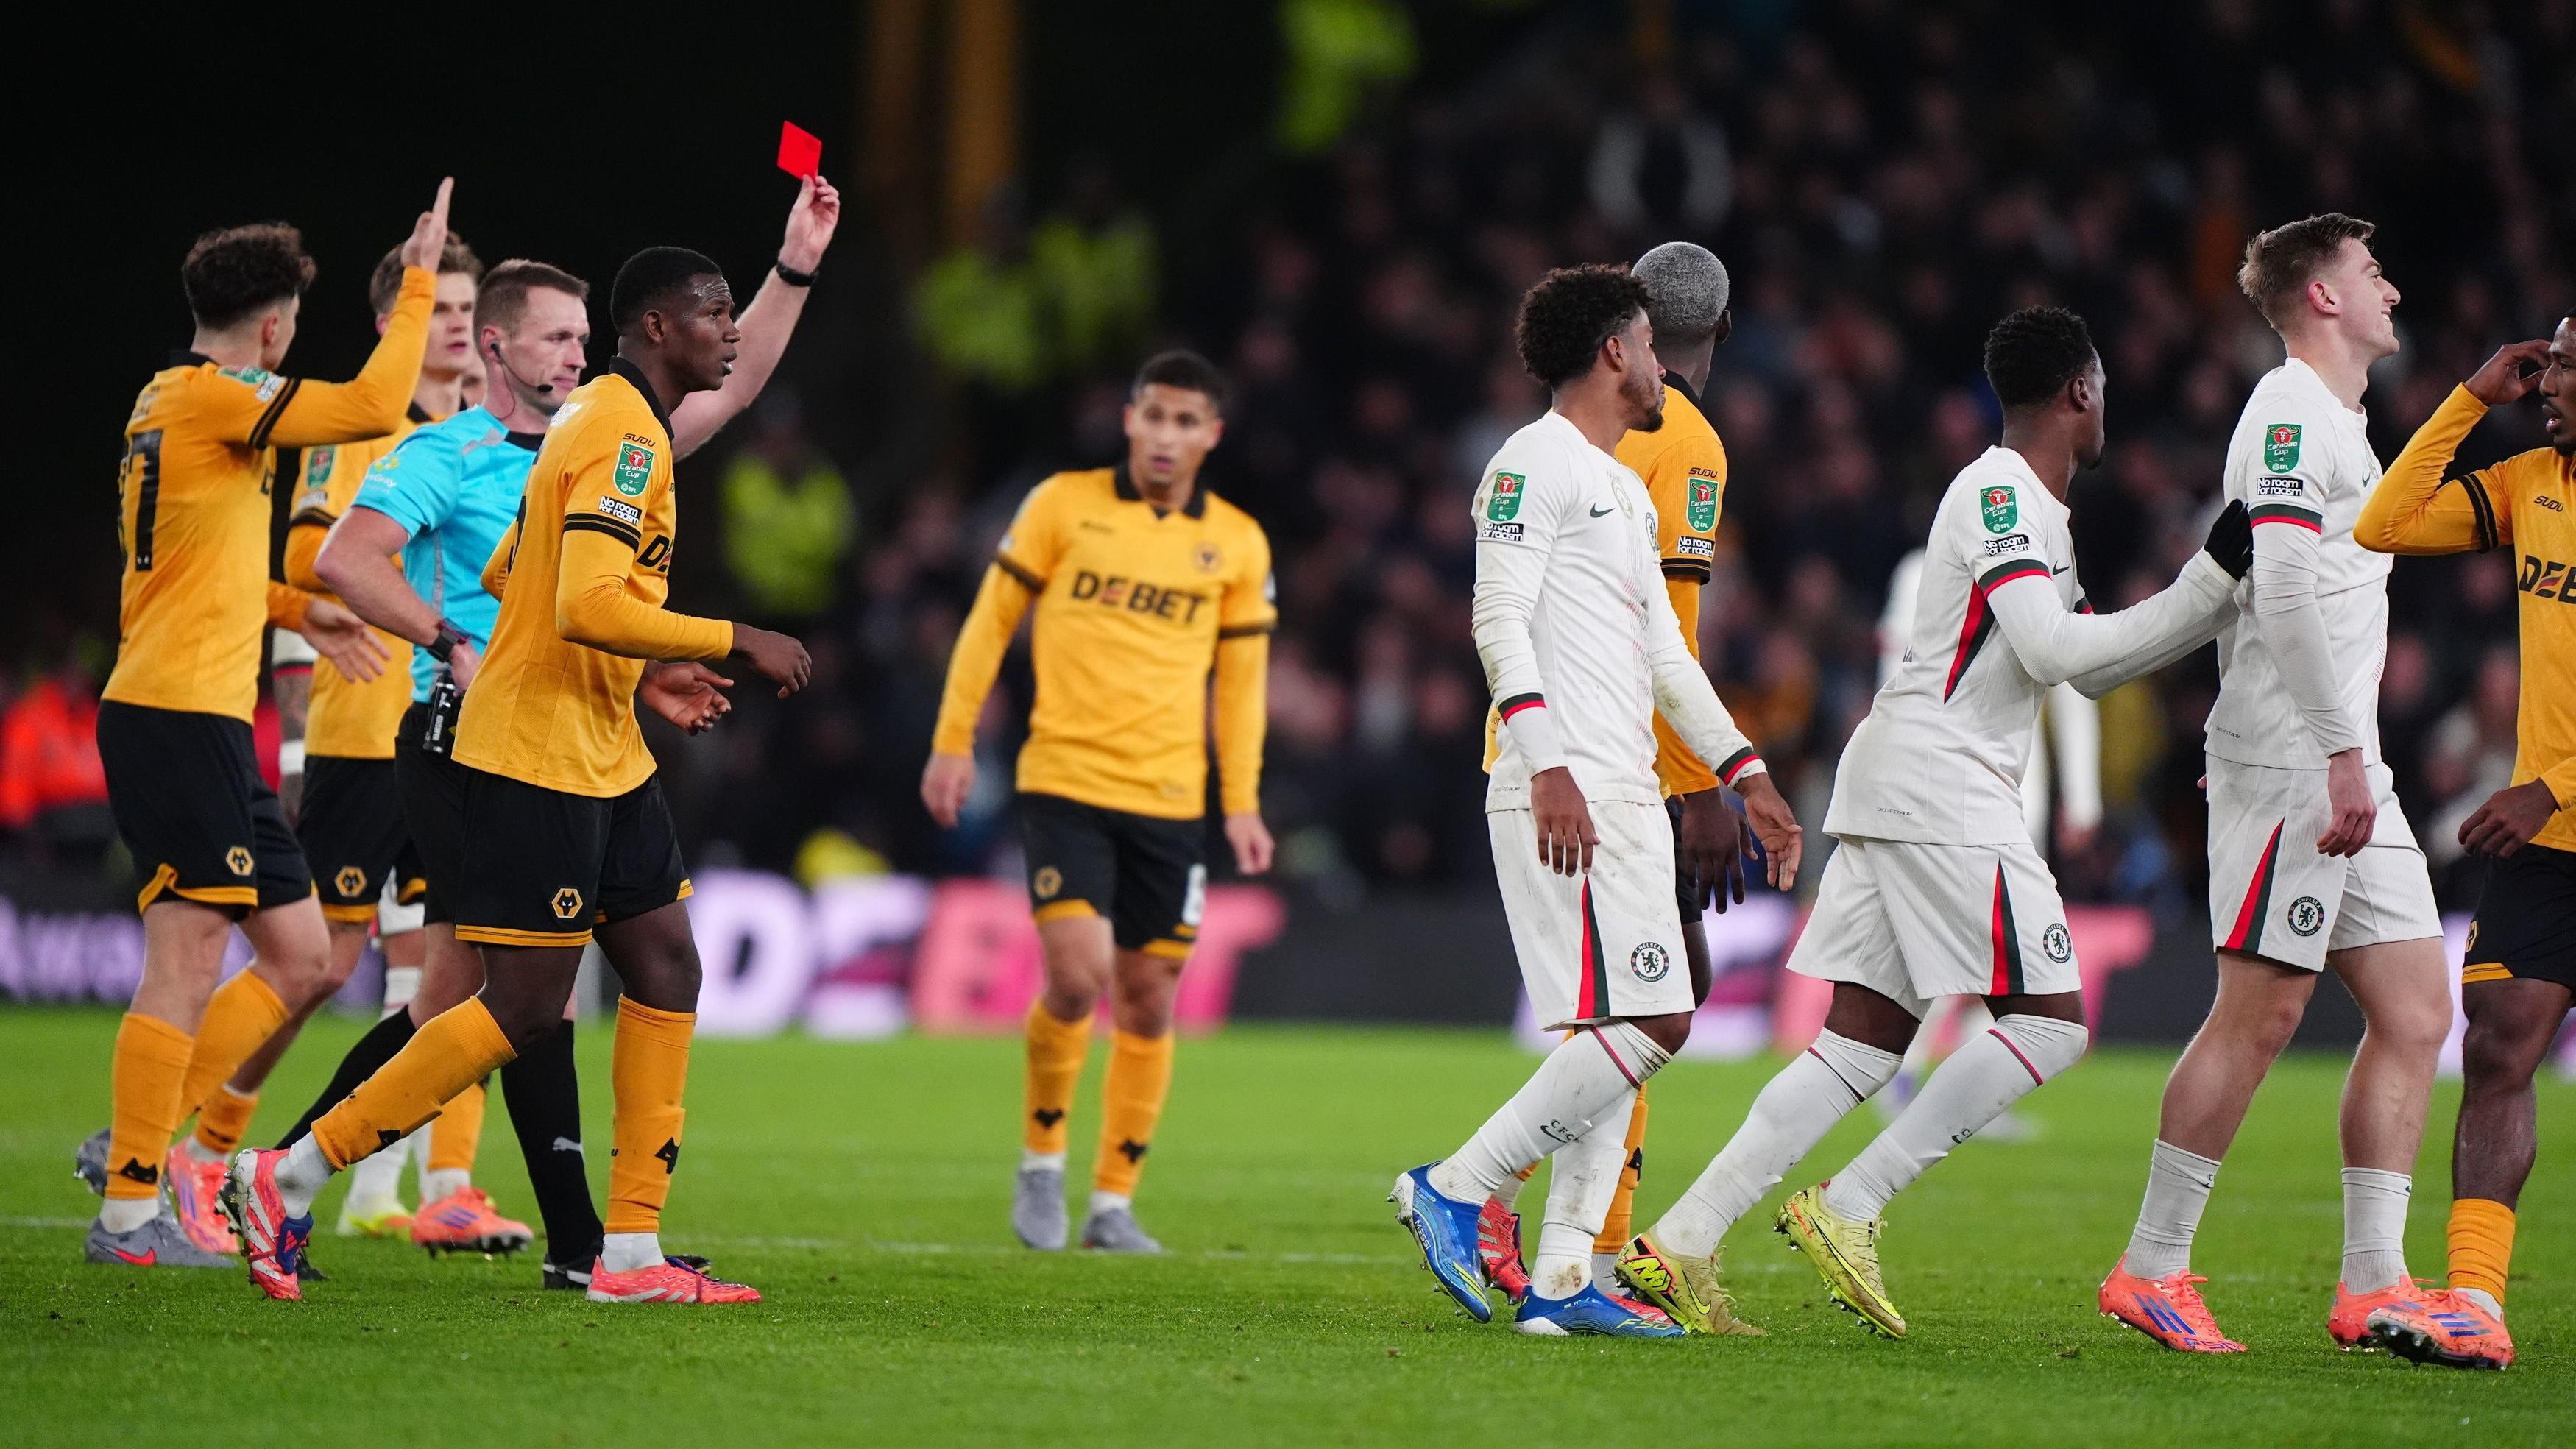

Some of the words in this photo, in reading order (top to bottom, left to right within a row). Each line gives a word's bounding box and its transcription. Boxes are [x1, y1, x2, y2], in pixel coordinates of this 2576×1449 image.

[623, 433, 656, 447] SUDU
[2268, 442, 2298, 450] Carabao
[620, 464, 648, 472] Carabao
[1688, 467, 1718, 478] SUDU
[2257, 478, 2271, 487] No
[2271, 479, 2299, 488] room
[2257, 486, 2270, 495] for
[2271, 486, 2302, 497] racism
[118, 429, 163, 571] 7
[600, 495, 615, 508] No
[615, 502, 638, 517] room
[2534, 495, 2564, 512] SUDU
[1984, 501, 2014, 514] Carabao
[1992, 509, 2007, 517] Cup
[598, 504, 613, 514] for
[613, 509, 639, 525] racism
[1483, 520, 1494, 530] No
[1493, 524, 1519, 534] room
[1491, 531, 1523, 542] racism
[1678, 536, 1691, 546] No
[1693, 539, 1712, 550] room
[1983, 540, 1998, 548] No
[1998, 536, 2025, 548] room
[1677, 545, 1691, 554] for
[1692, 547, 1713, 558] racism
[2000, 543, 2030, 553] racism
[2519, 554, 2576, 604] DEB
[1072, 570, 1209, 624] DEBET
[2297, 898, 2321, 909] CHELSEA
[2046, 924, 2064, 935] CHELSEA
[1635, 942, 1660, 954] CHELSEA
[688, 871, 1287, 1039] DEBT
[1415, 1219, 1432, 1250] MESSI
[1616, 1318, 1672, 1331] F50
